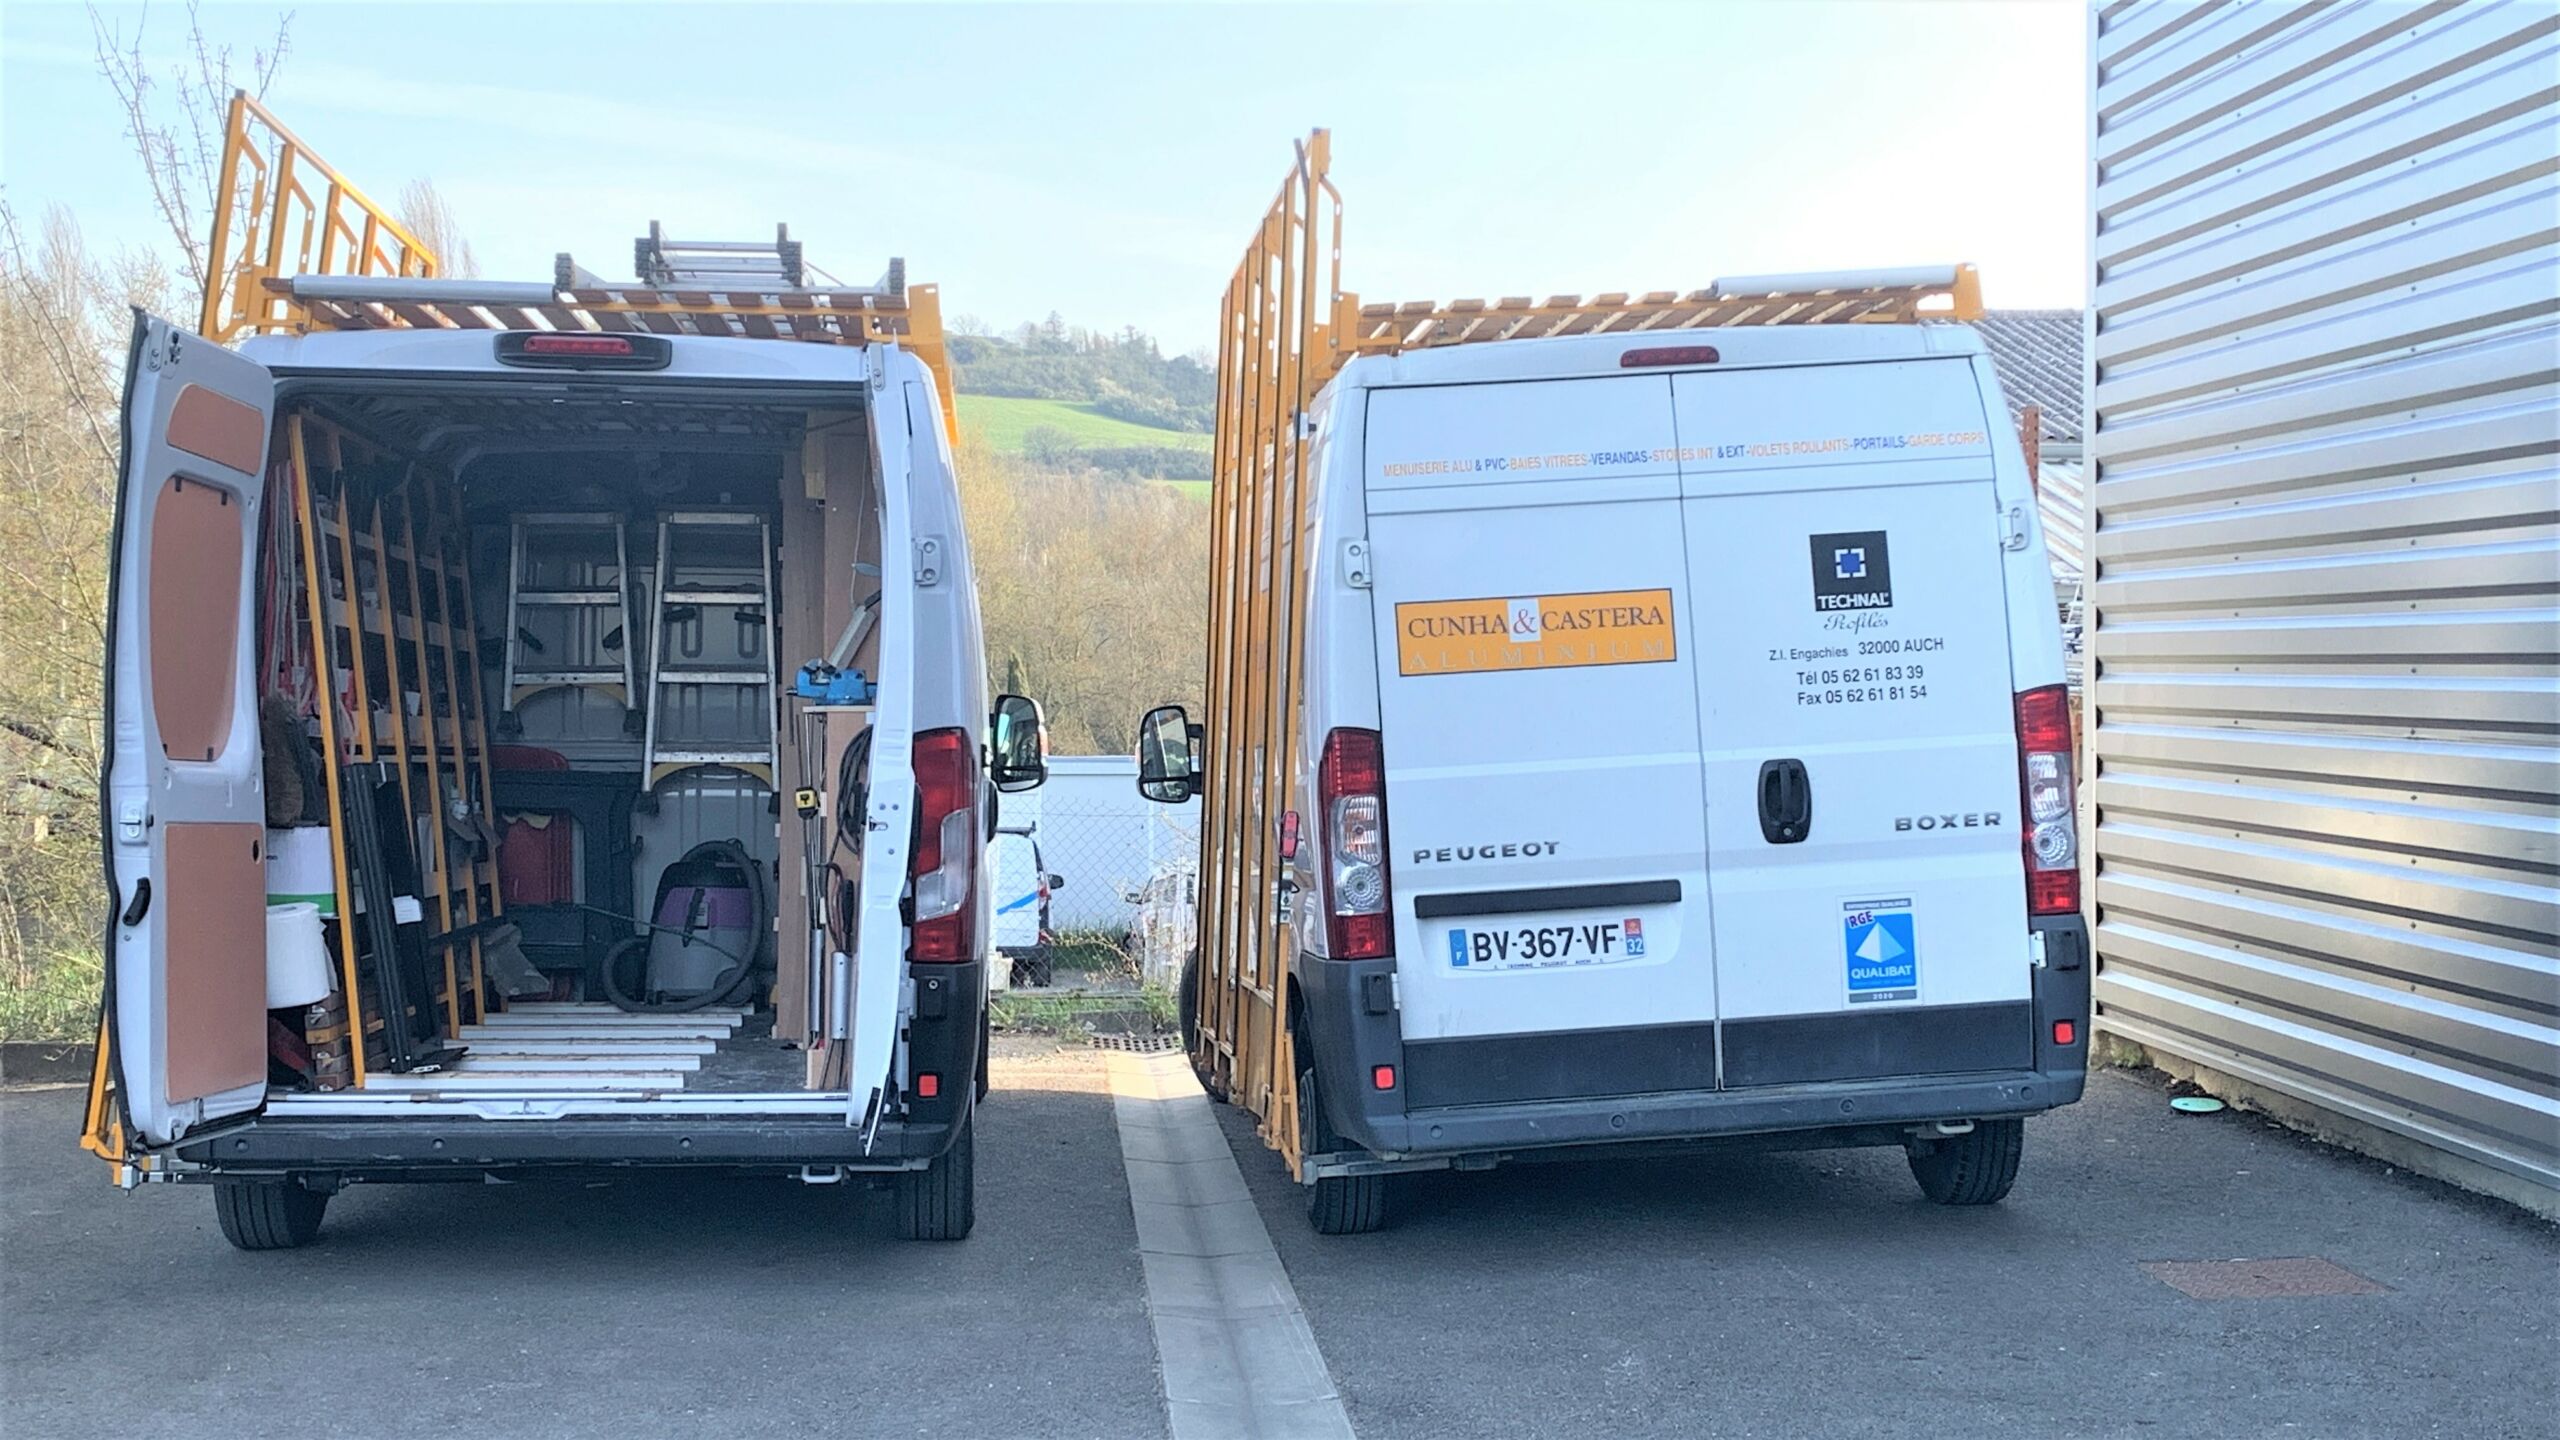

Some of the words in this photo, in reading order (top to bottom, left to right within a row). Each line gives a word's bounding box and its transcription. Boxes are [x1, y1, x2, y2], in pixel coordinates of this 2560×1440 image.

[1383, 461, 1449, 477] MENUISERIE
[1452, 459, 1472, 473] ALU
[1475, 459, 1482, 472] &
[1697, 447, 1714, 460] INT
[1717, 446, 1724, 459] &
[1947, 431, 1984, 446] CORPS
[1817, 592, 1889, 609] TECHNAL
[1408, 614, 1509, 638] CUNHA
[1541, 606, 1664, 632] CASTERA
[1823, 611, 1889, 634] Profilés
[1409, 639, 1665, 670] ALUMINIUM
[1769, 650, 1788, 661] Z.I.
[1790, 647, 1849, 662] Engachies
[1858, 640, 1900, 655] 32000
[1904, 637, 1944, 652] AUCH
[1797, 669, 1818, 685] Tél
[1821, 670, 1839, 684] 05
[1843, 669, 1860, 683] 62
[1864, 668, 1880, 682] 61
[1885, 666, 1903, 680] 83
[1906, 665, 1924, 679] 39
[1798, 690, 1822, 705] Fax
[1825, 690, 1843, 704] 05
[1847, 688, 1864, 702] 62
[1868, 687, 1884, 701] 61
[1889, 686, 1905, 700] 81
[1910, 685, 1927, 699] 54
[1894, 812, 2002, 831] BOXER
[1413, 841, 1560, 864] PEUGEOT
[1849, 911, 1873, 927] RGE
[1473, 924, 1619, 962] BV-367-VF
[1627, 937, 1643, 953] 32
[1455, 951, 1463, 961] F
[1851, 965, 1912, 980] QUALIBAT
